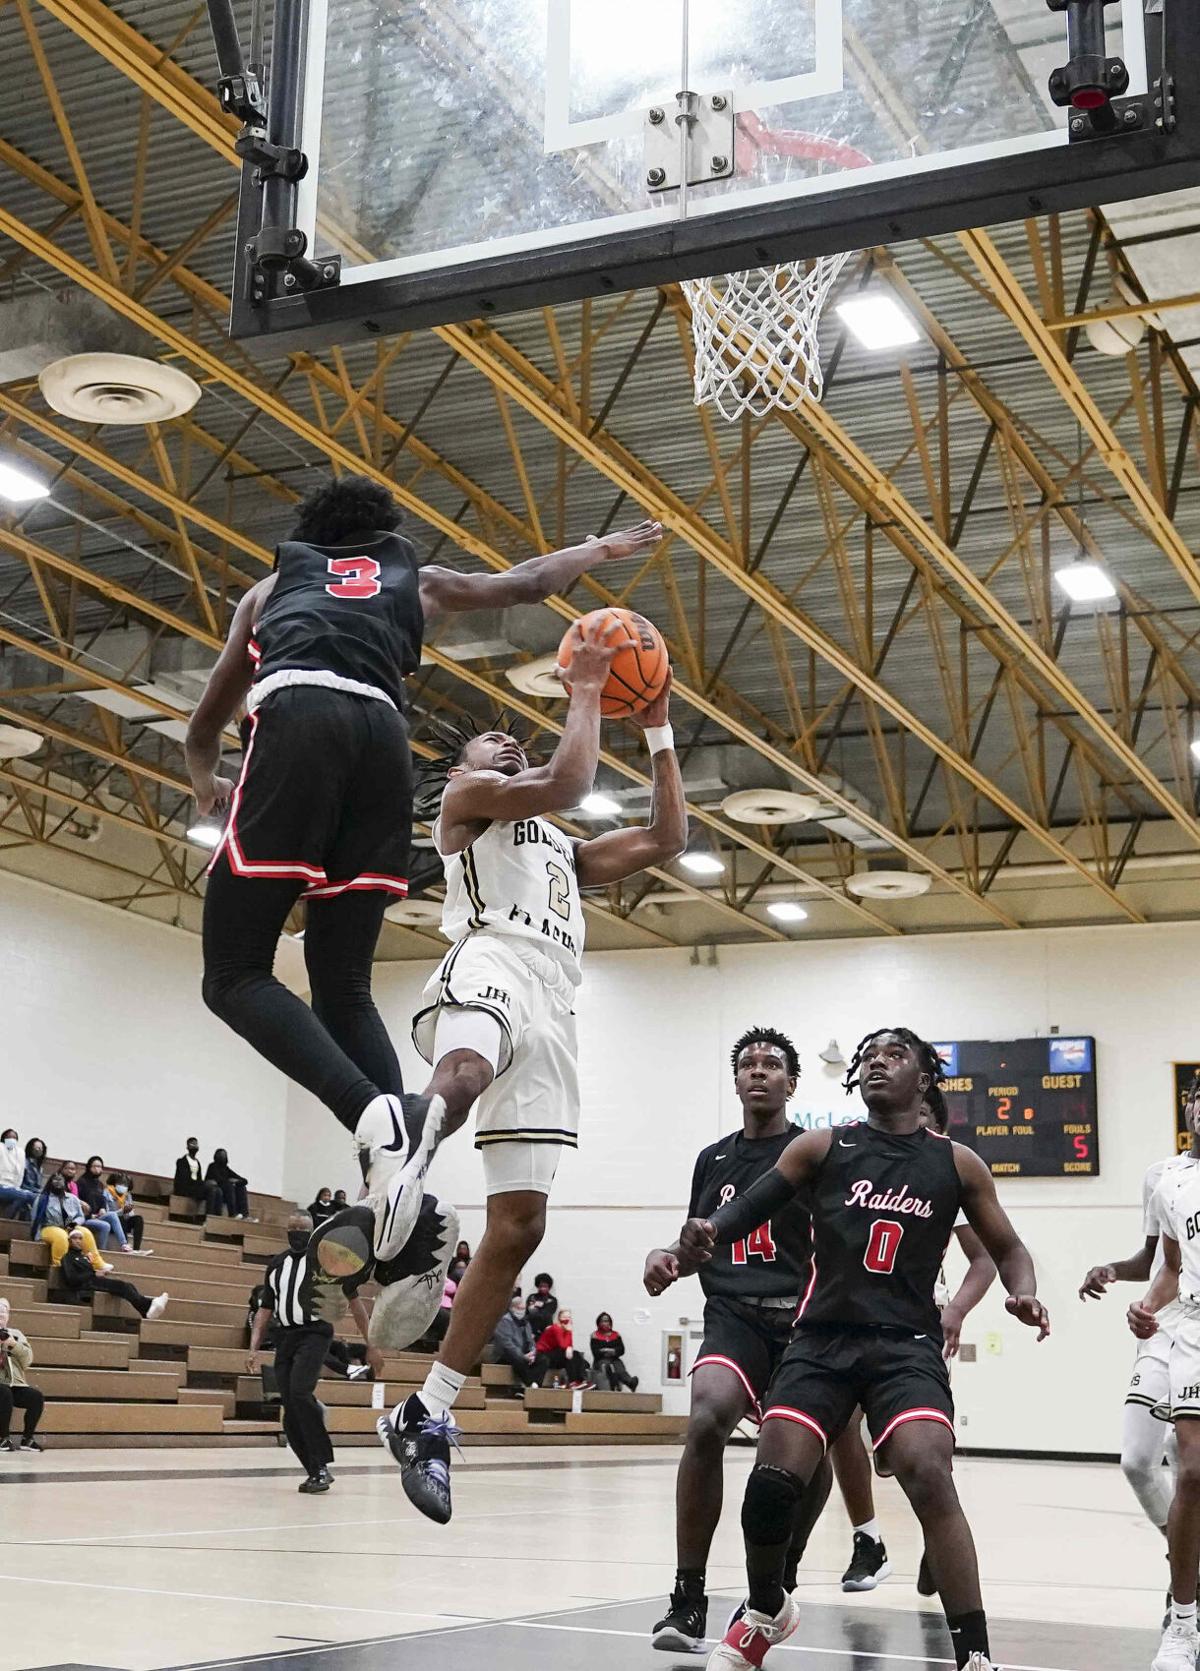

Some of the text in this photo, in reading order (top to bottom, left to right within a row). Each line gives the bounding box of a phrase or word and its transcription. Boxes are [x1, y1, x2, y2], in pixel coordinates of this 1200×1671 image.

[325, 556, 381, 598] 3
[546, 861, 570, 921] 2
[988, 1086, 1019, 1096] PERIOD
[1042, 1074, 1082, 1089] GUEST
[997, 1097, 1012, 1120] 2
[976, 1124, 1034, 1136] PLAYER FOUL
[1063, 1123, 1092, 1134] FOULS
[1073, 1135, 1089, 1159] 5
[1063, 1161, 1092, 1172] SCORE
[844, 1180, 933, 1219] Raiders
[863, 1219, 904, 1275] 0
